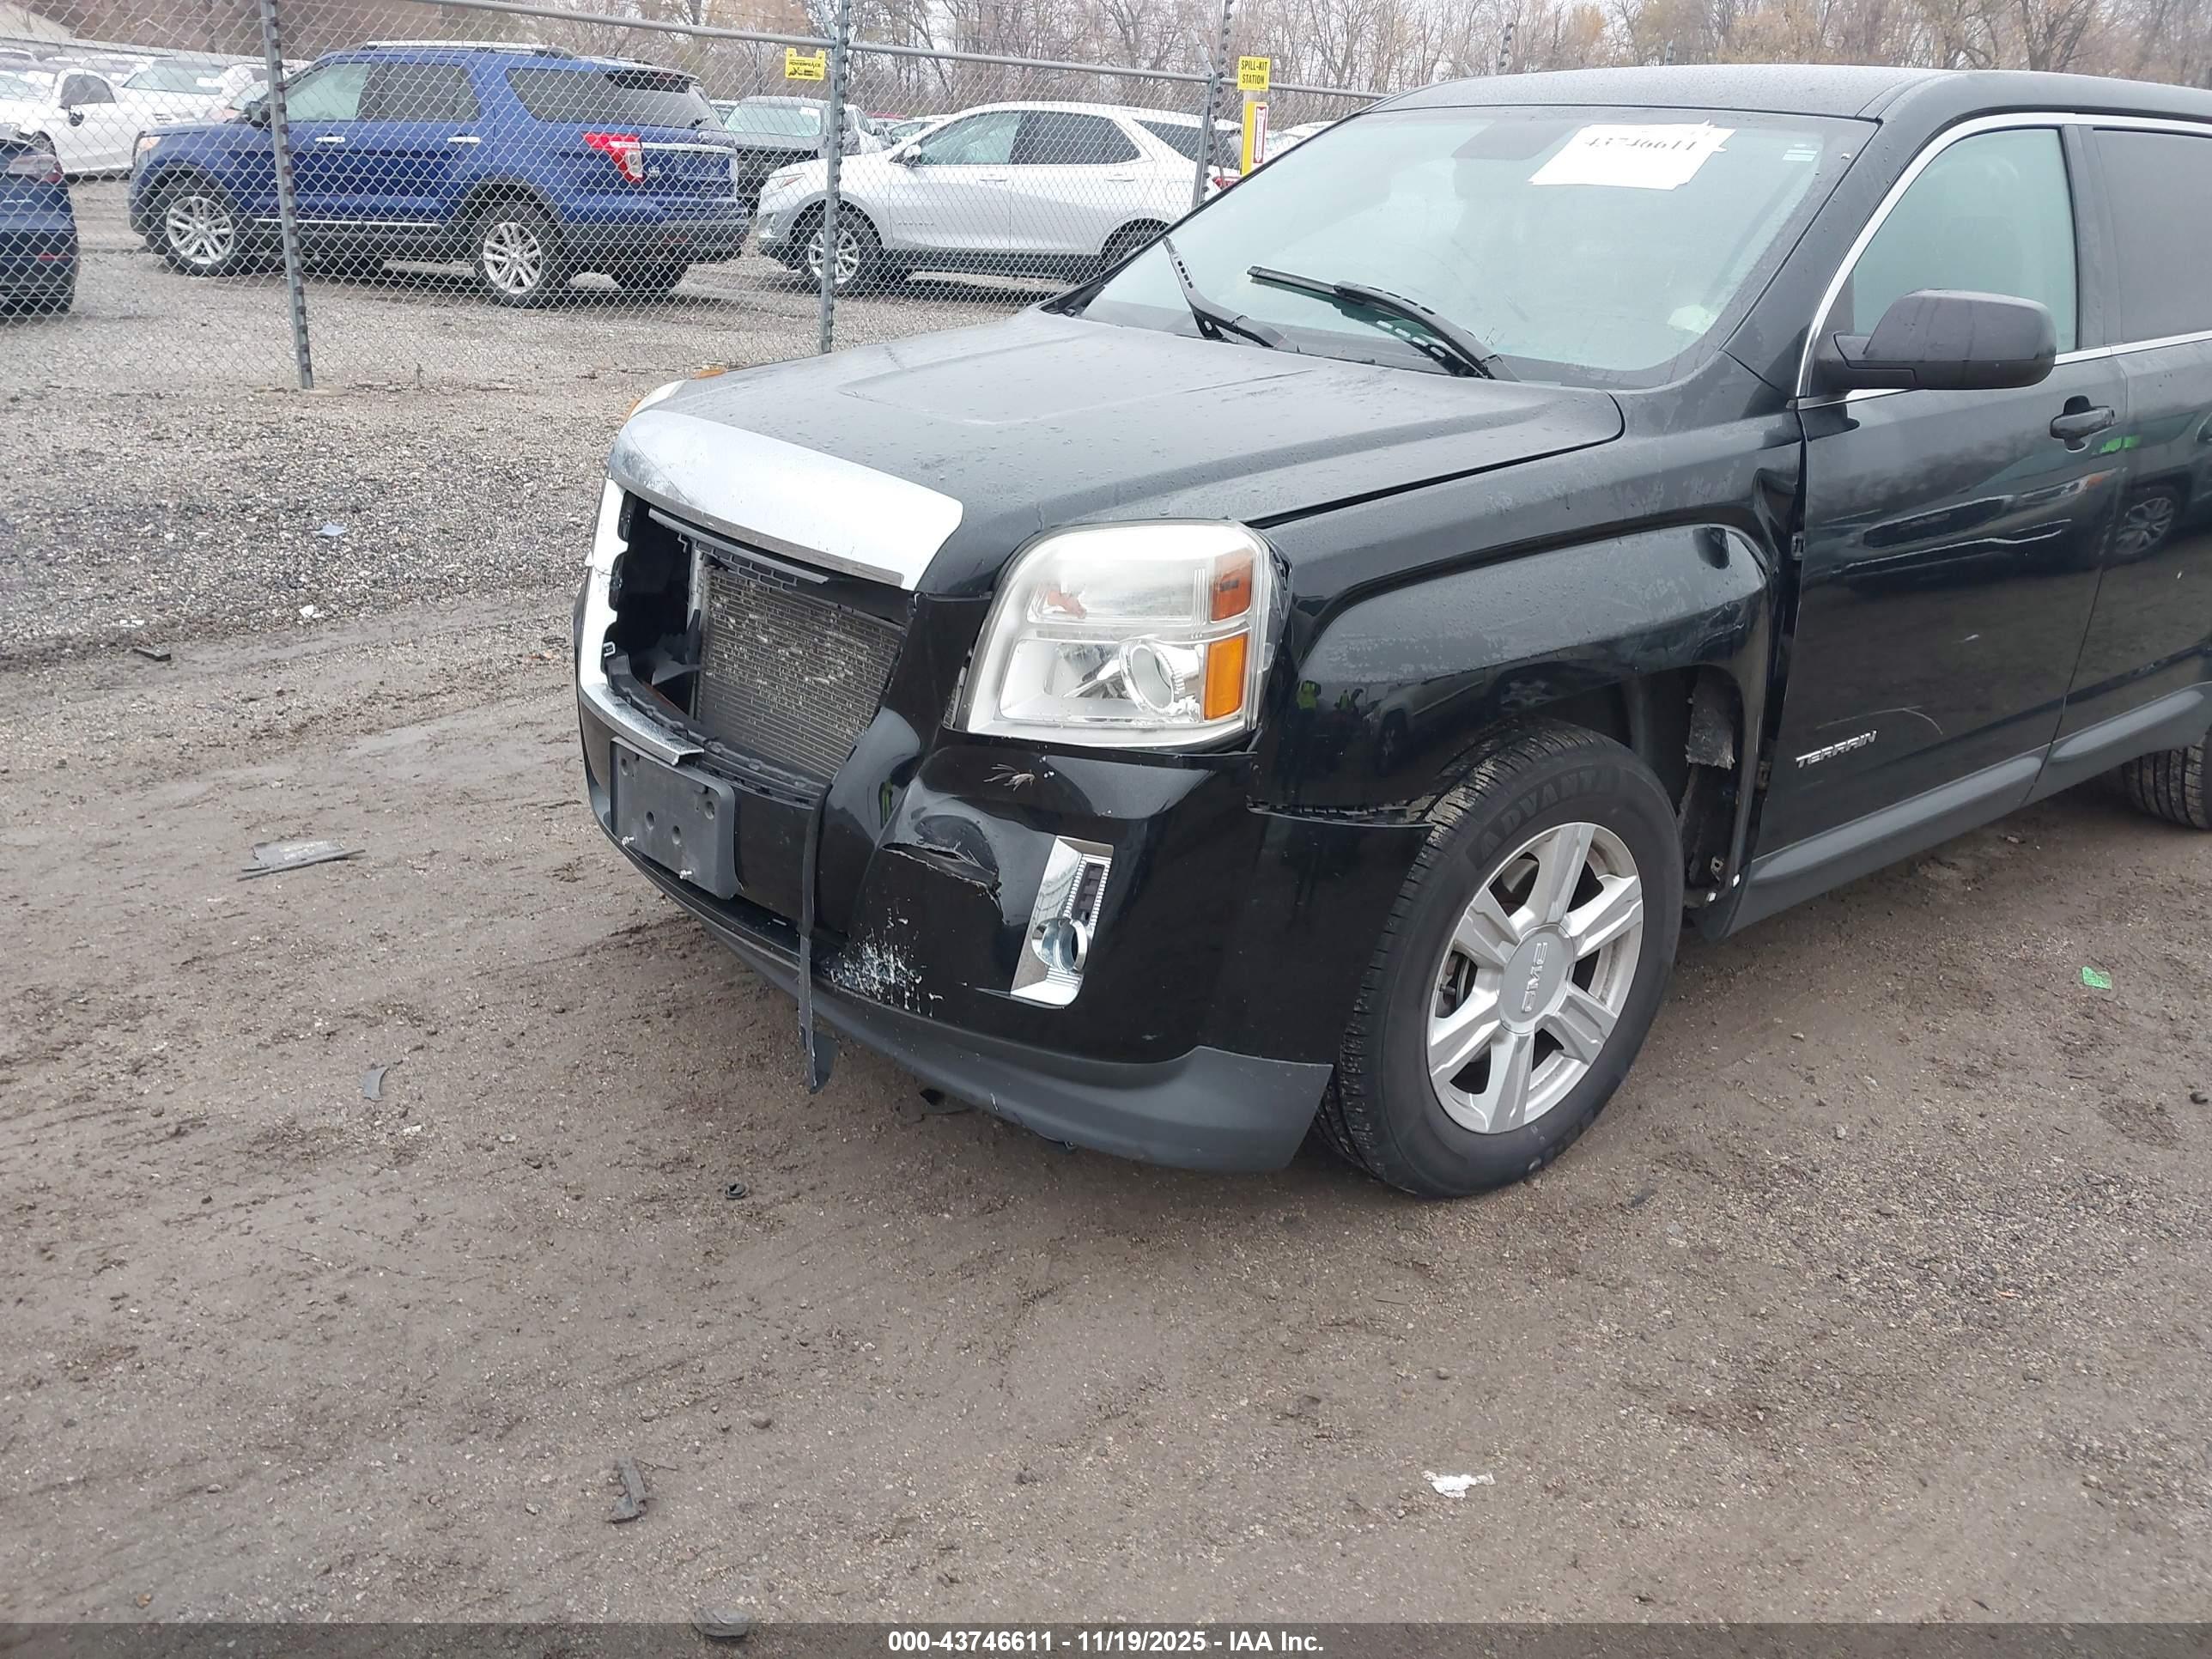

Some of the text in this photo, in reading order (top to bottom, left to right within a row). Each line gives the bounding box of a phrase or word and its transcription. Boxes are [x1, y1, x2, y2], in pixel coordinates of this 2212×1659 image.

[1241, 60, 1267, 71] SPILL-KIT
[1242, 74, 1265, 85] STATION
[1796, 730, 1877, 769] TERRAIN
[1521, 942, 1548, 1012] GMC
